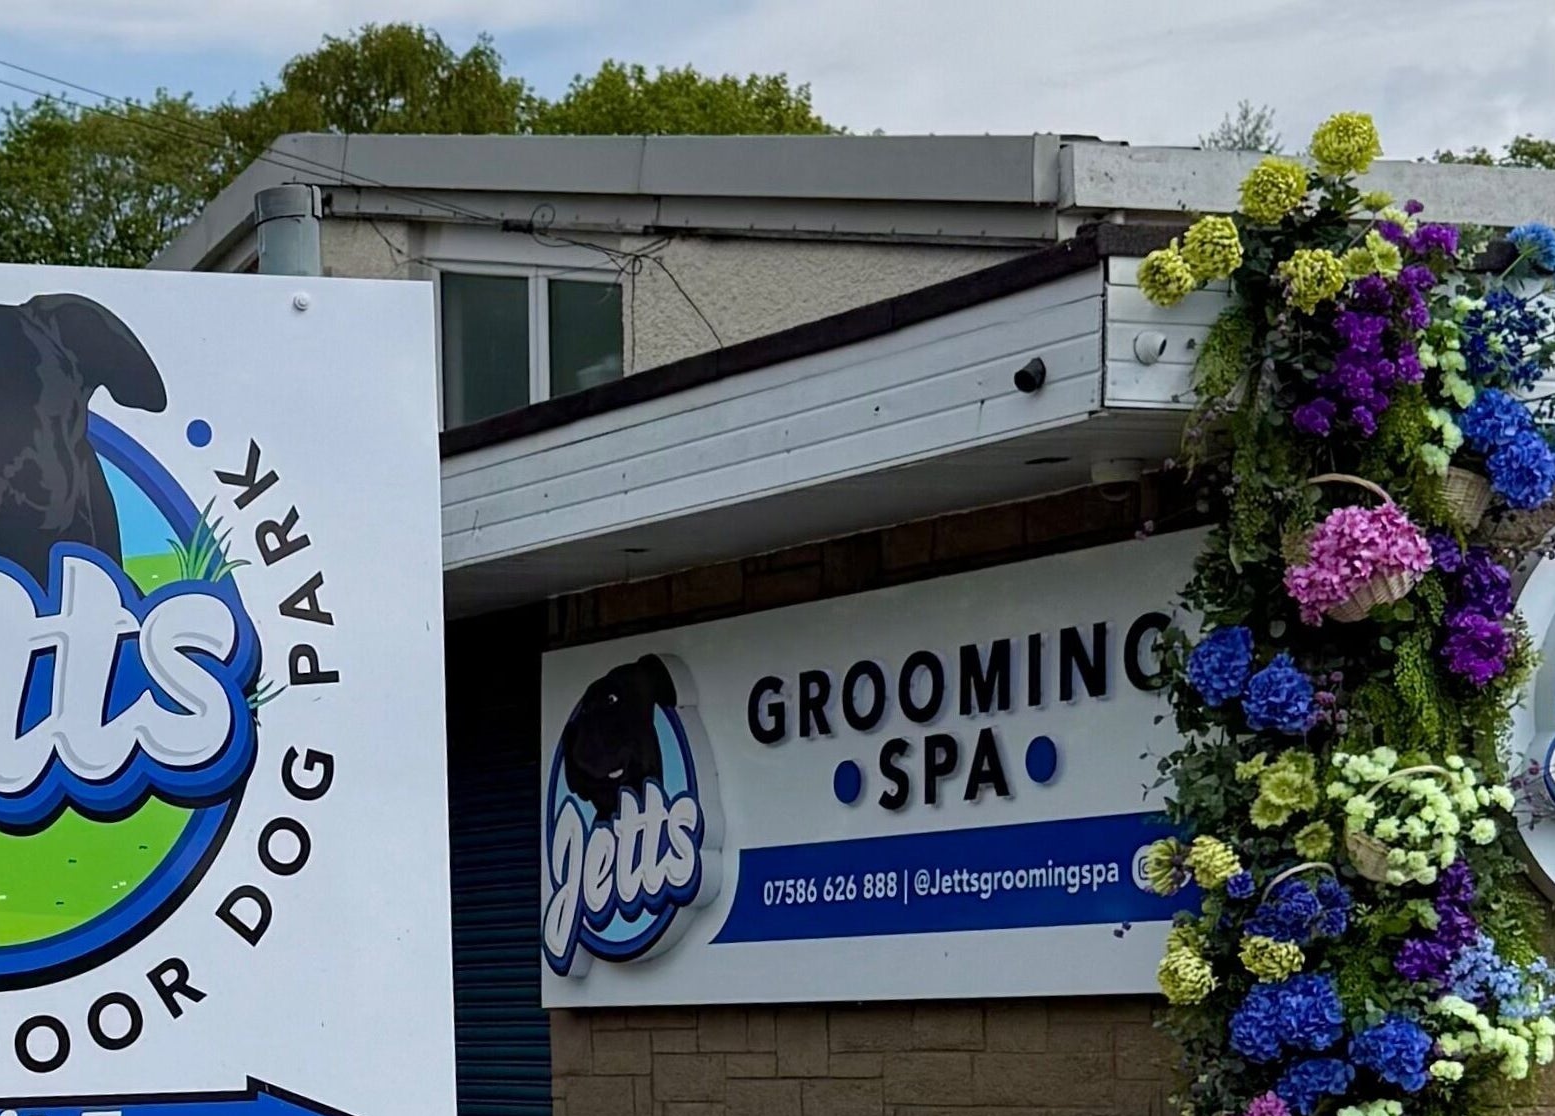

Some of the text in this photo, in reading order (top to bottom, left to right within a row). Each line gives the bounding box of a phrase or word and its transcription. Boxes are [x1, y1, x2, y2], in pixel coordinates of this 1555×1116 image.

[215, 437, 341, 687] PARK
[215, 746, 337, 948] DOG
[877, 727, 1014, 811] SPA
[544, 780, 698, 959] Jetts
[763, 878, 817, 906] 07586
[823, 874, 857, 902] 626
[863, 871, 898, 899] 888
[914, 859, 1120, 900] @Jettsgroomingspa
